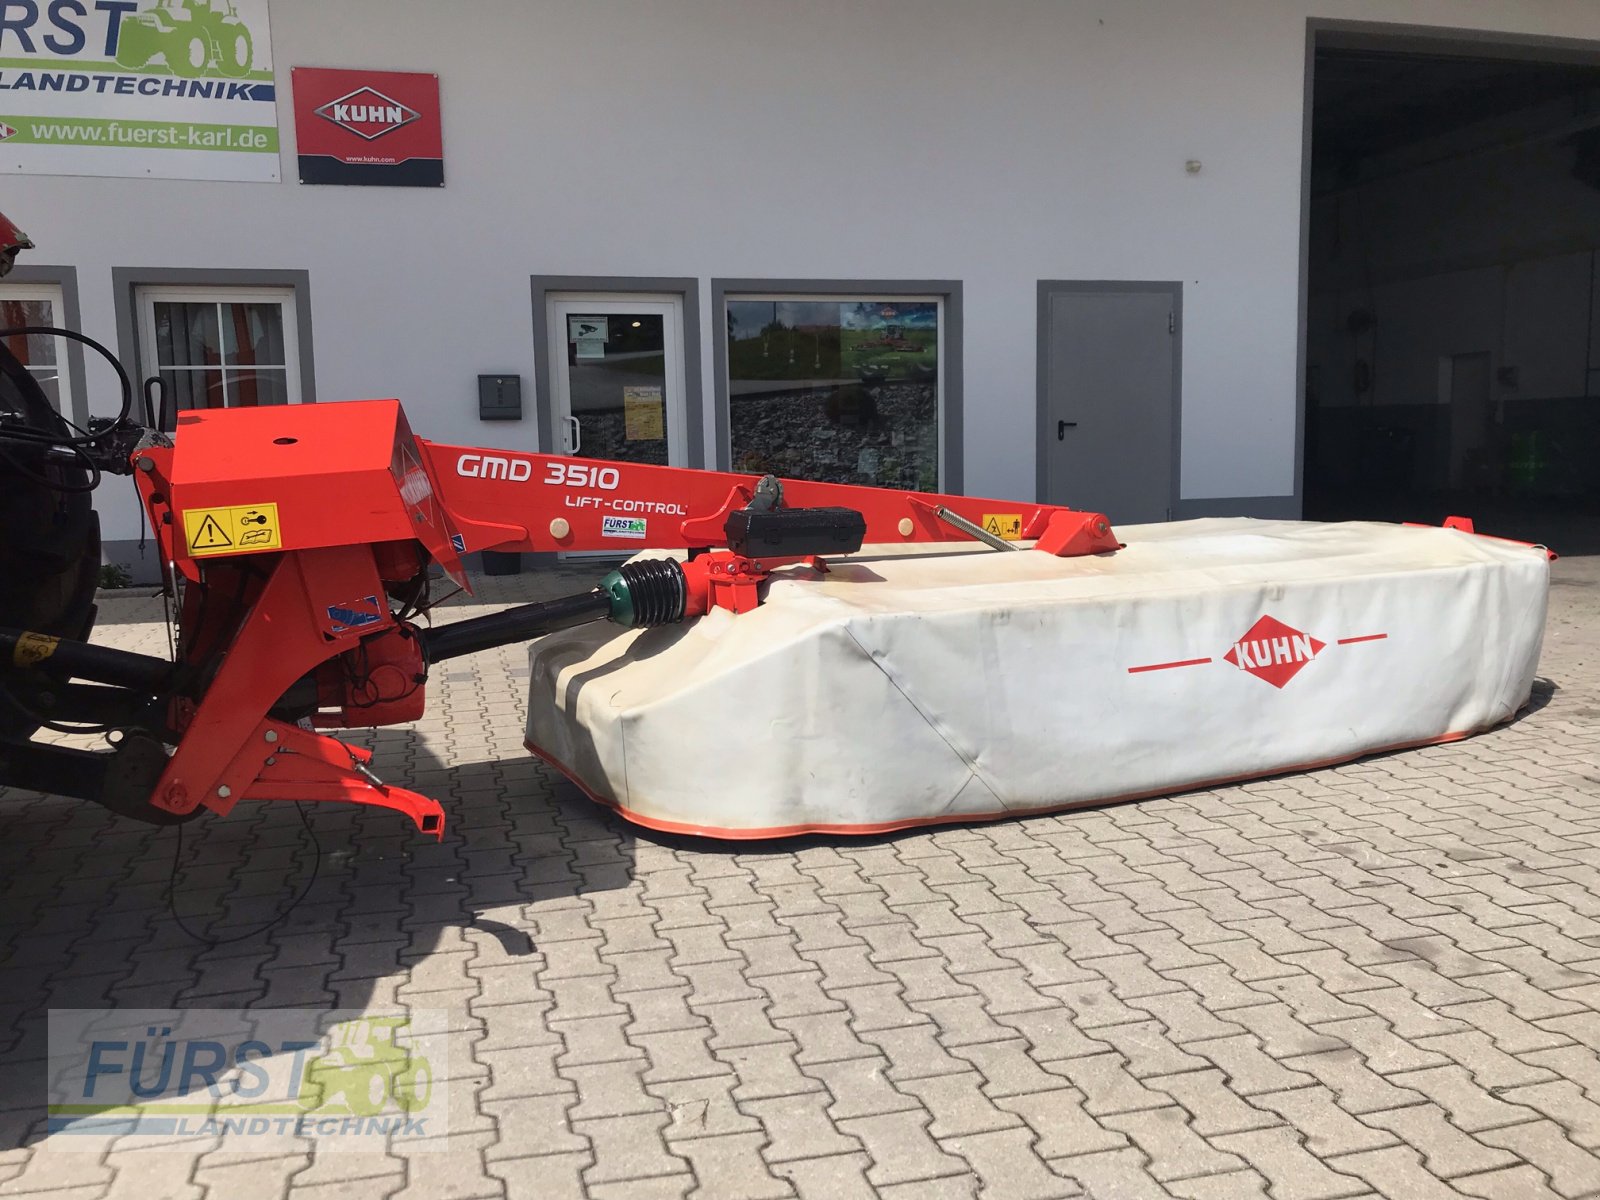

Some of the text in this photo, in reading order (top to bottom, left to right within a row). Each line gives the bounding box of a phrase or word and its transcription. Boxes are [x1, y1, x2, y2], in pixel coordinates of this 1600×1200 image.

[334, 104, 403, 123] KUHN
[31, 122, 268, 148] www.fuerst-karl.de
[457, 454, 620, 491] GMD 3510
[565, 495, 687, 515] LIFT-CONTROL
[603, 517, 634, 529] FÜRST
[1233, 632, 1315, 670] KUHN
